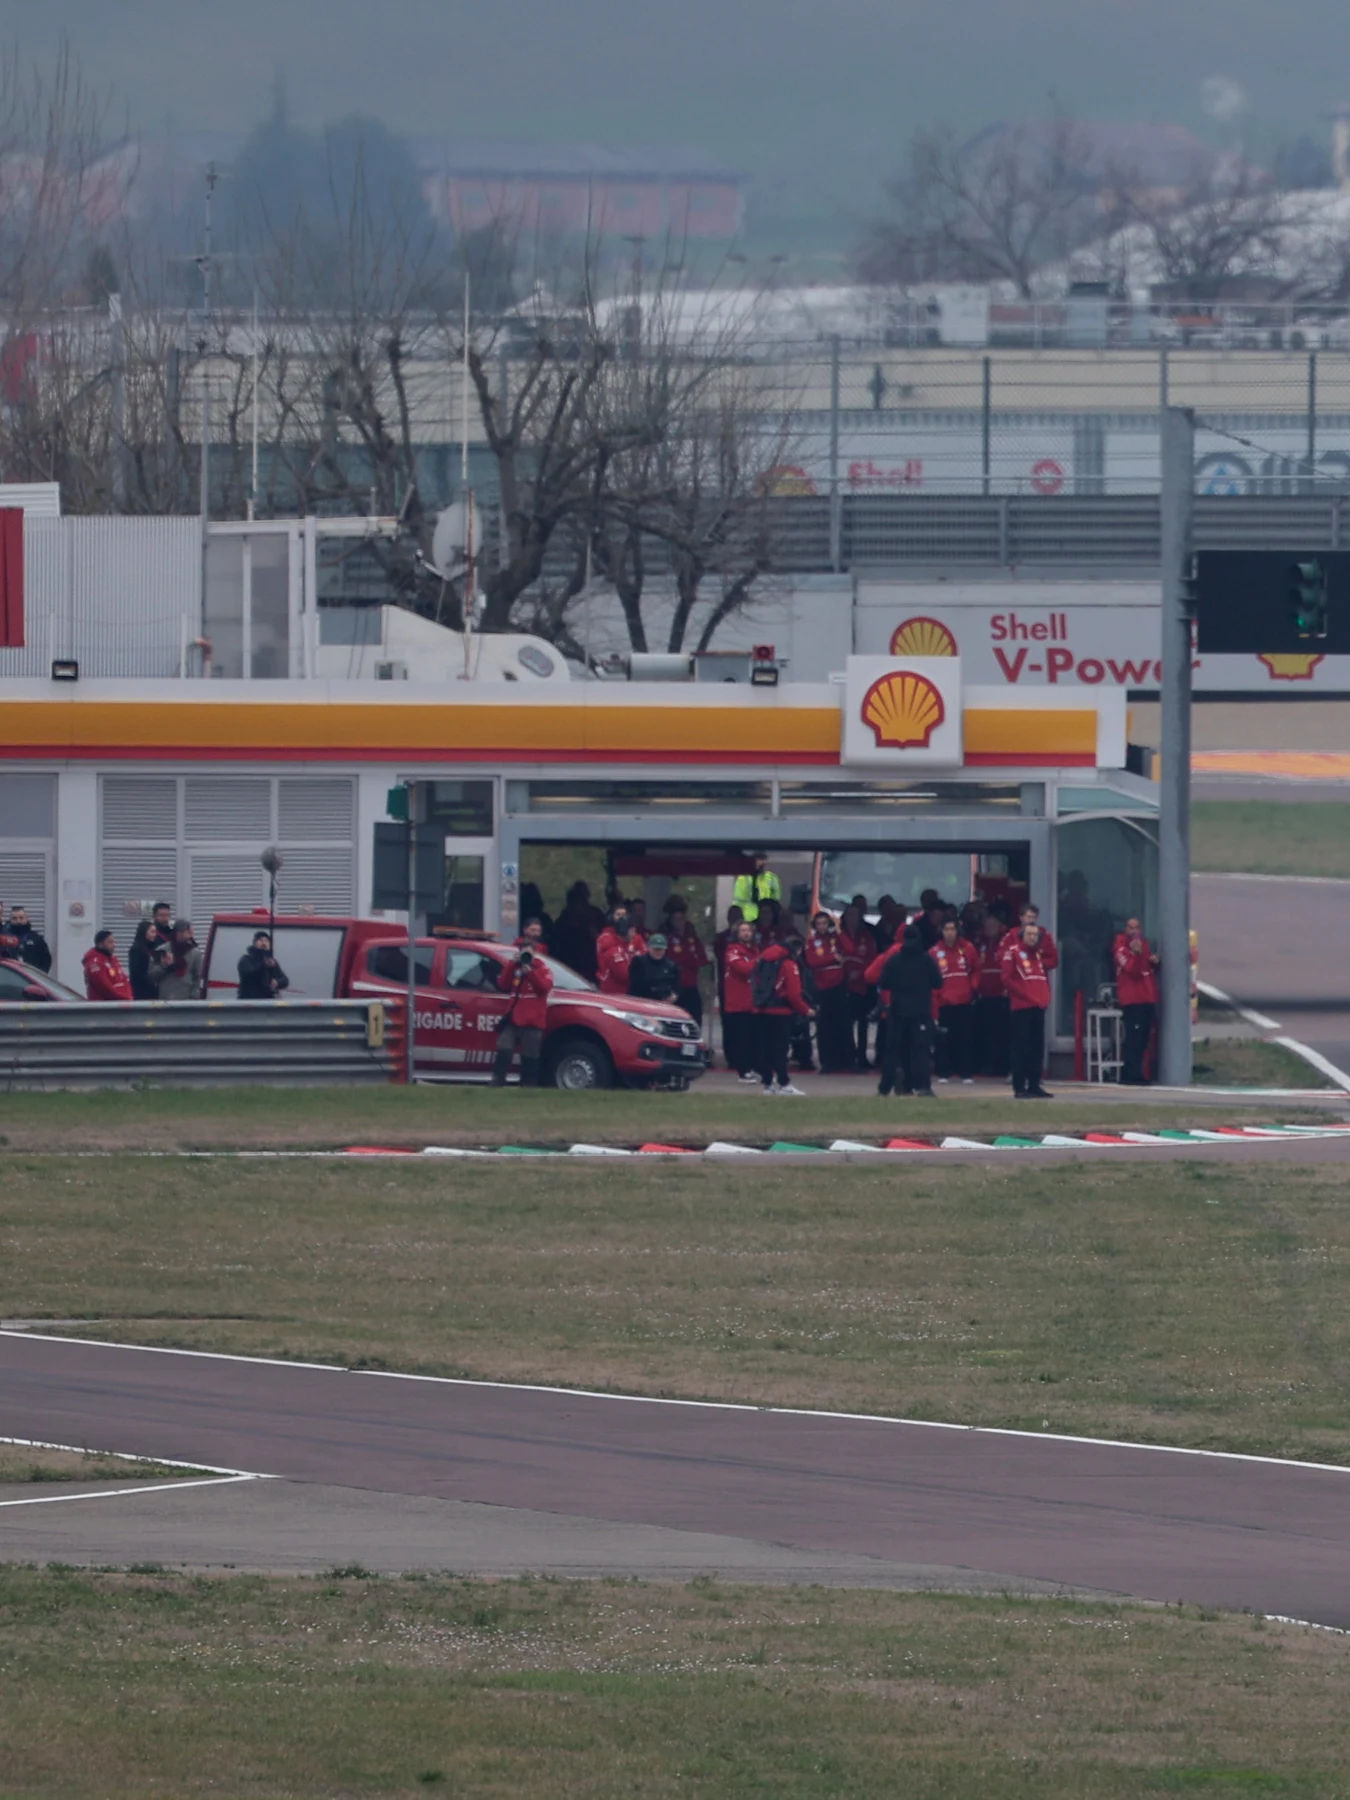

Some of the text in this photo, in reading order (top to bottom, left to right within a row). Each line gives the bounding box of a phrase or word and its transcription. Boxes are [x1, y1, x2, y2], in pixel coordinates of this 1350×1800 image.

[848, 459, 922, 488] Shell
[992, 614, 1067, 641] Shell
[994, 647, 1200, 684] V-Pow
